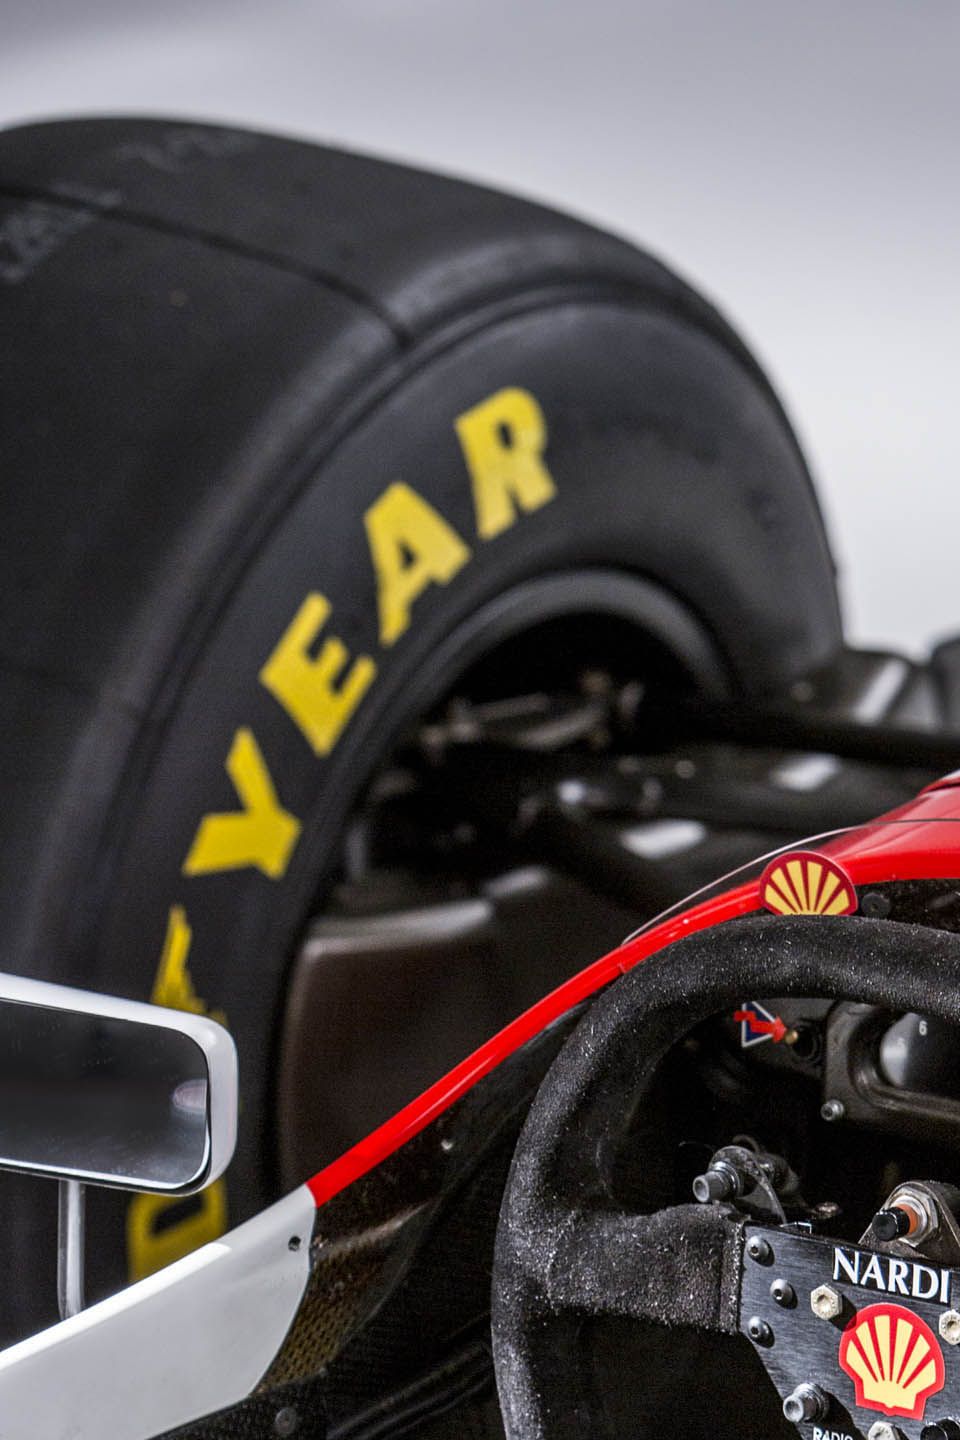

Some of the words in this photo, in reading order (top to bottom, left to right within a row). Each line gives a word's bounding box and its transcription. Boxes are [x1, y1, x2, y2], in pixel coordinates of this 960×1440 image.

[182, 386, 558, 880] YEAR
[918, 1020, 928, 1036] 6
[832, 1248, 950, 1304] NARDI
